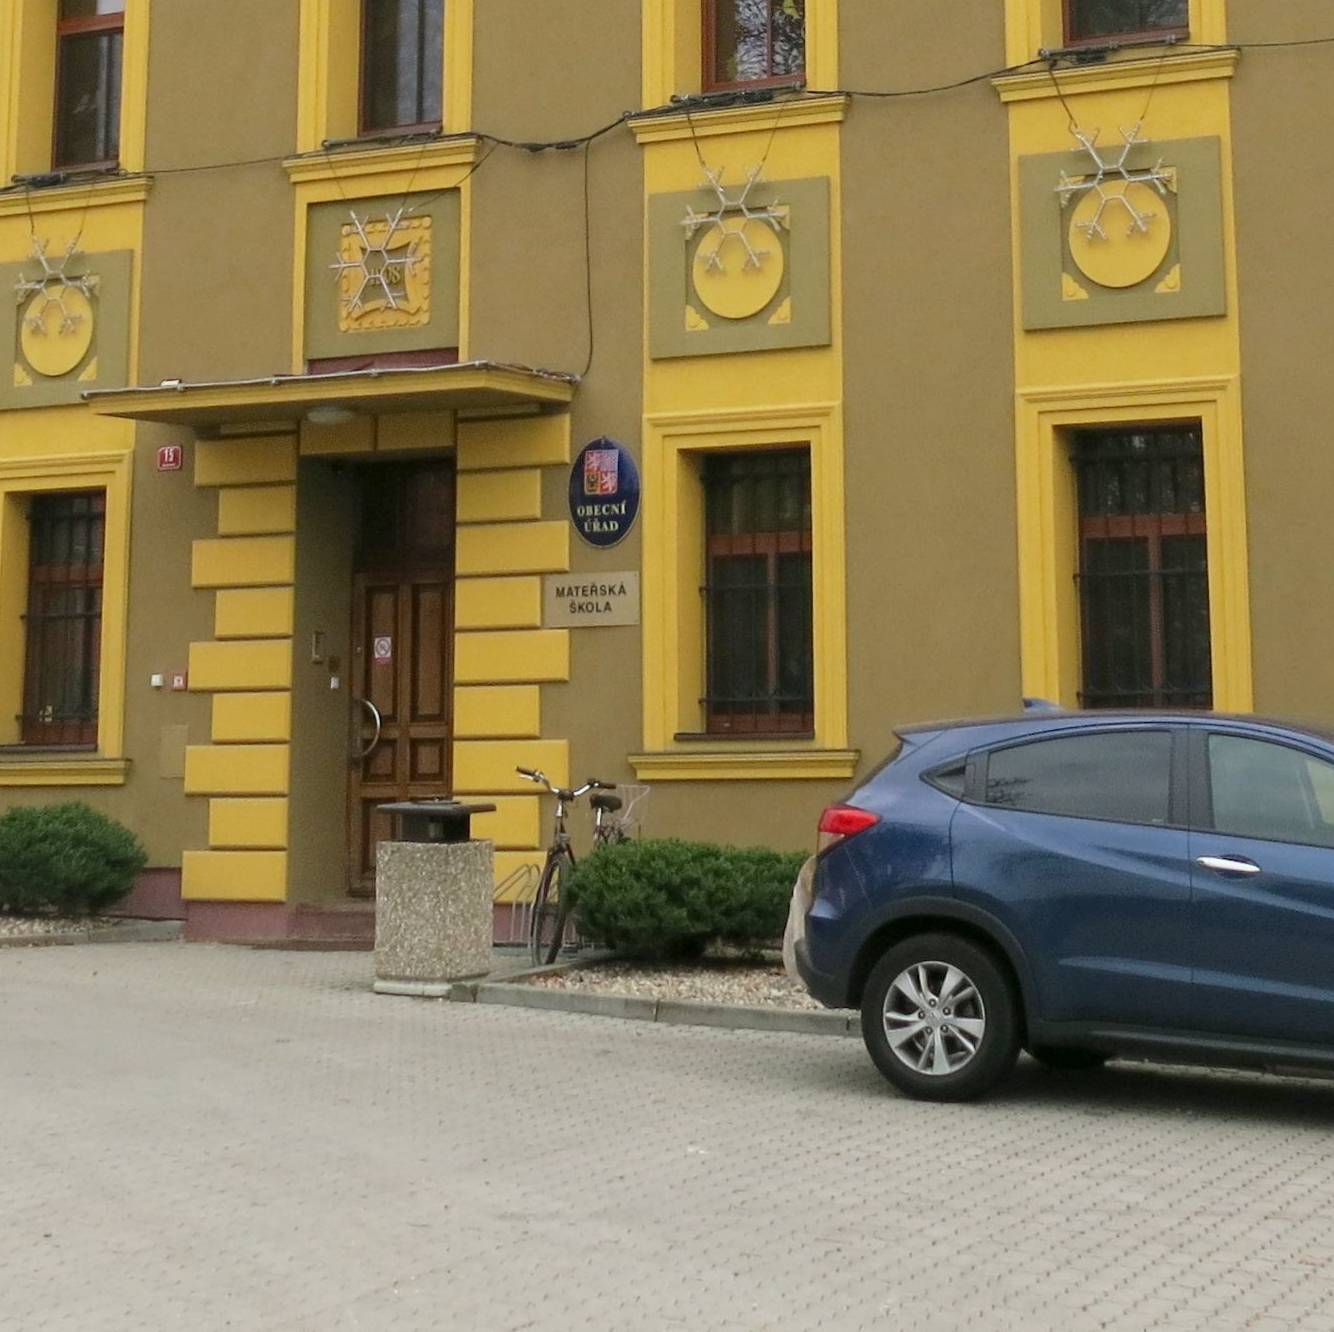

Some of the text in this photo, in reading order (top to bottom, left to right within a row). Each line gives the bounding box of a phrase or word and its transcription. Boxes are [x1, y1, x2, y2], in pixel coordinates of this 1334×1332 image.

[576, 500, 627, 517] OBECNÍ
[584, 518, 619, 532] ÚŘAD
[555, 582, 627, 598] MATEŘSKÁ
[569, 599, 612, 614] ŠKOLA
